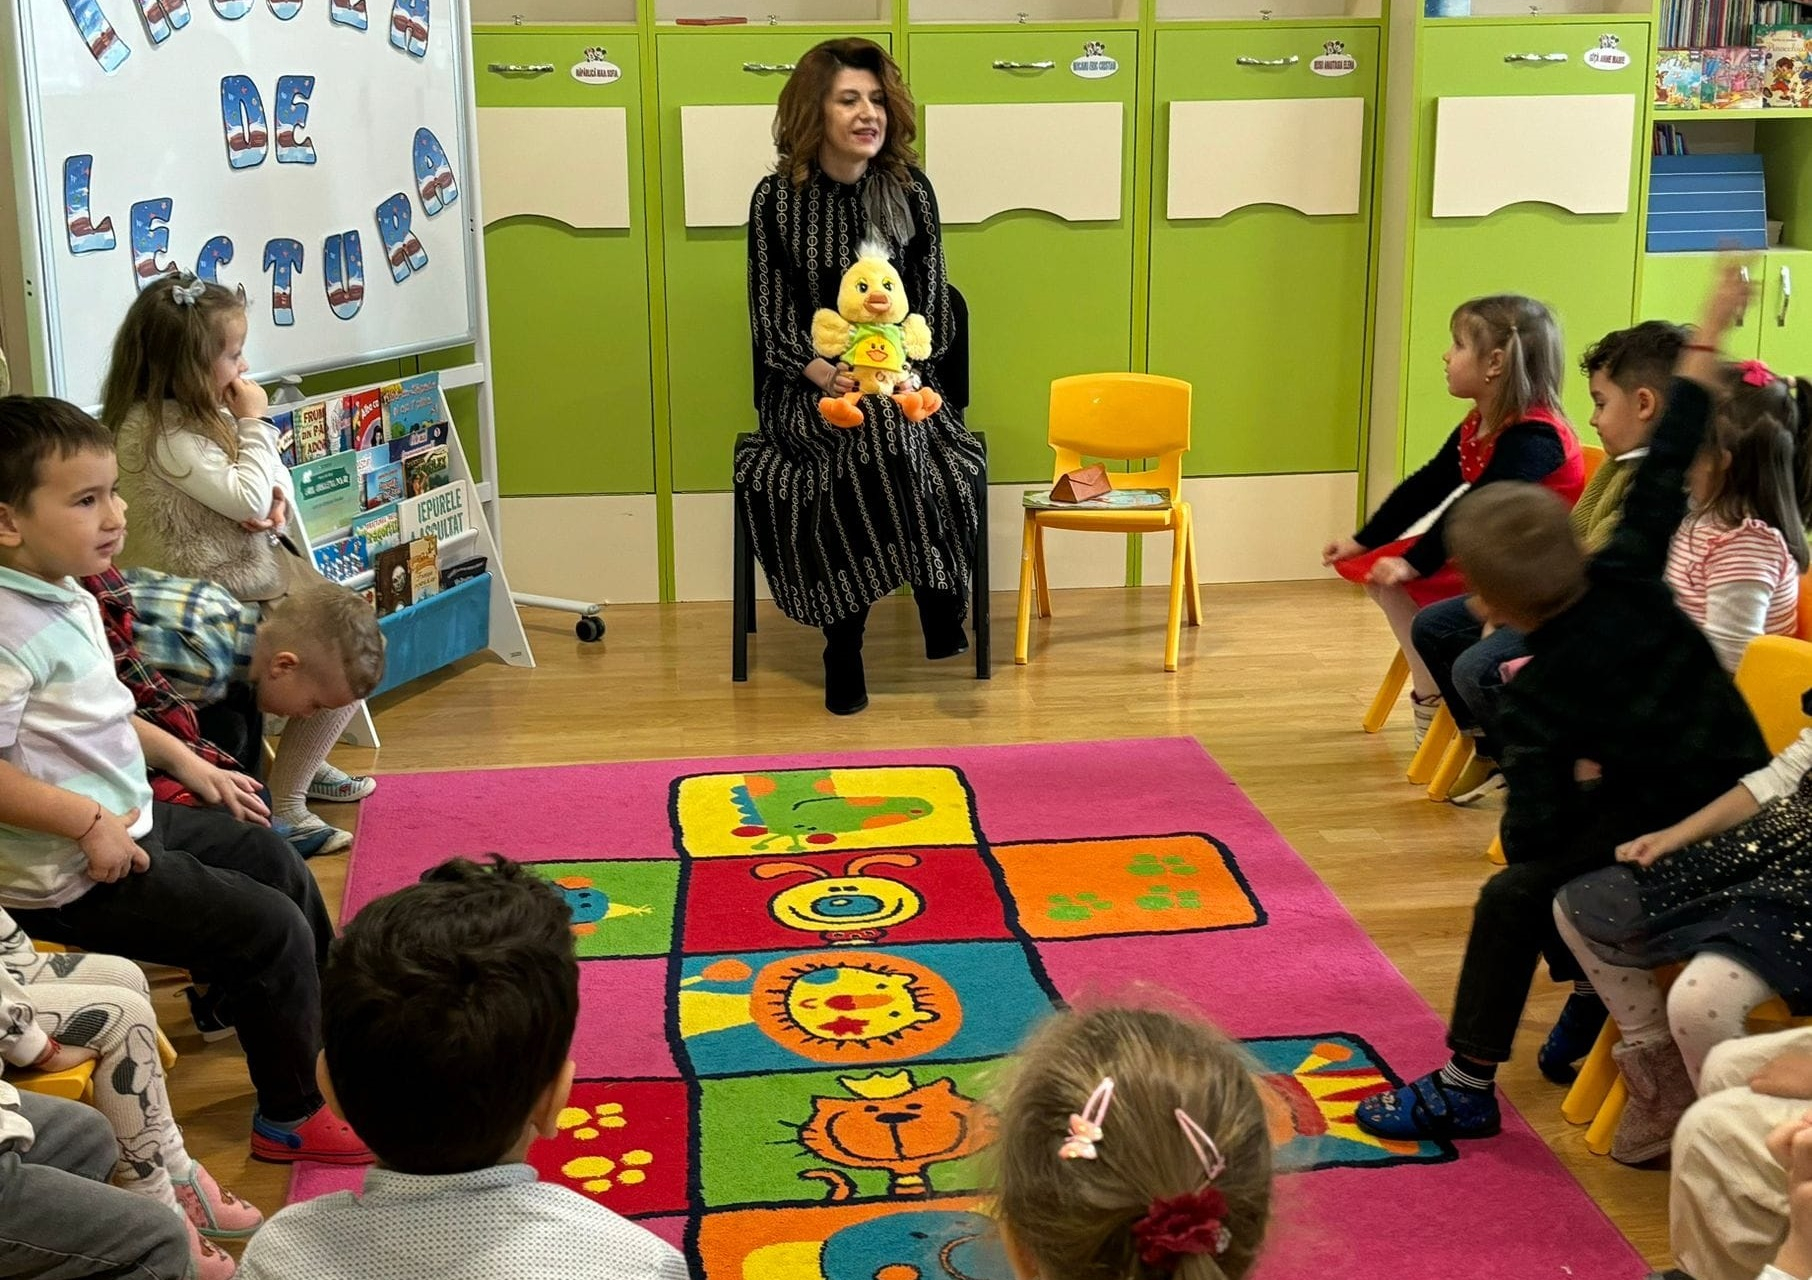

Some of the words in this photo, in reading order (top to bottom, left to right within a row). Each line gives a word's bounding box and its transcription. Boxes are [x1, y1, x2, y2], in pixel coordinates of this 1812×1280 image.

[220, 75, 317, 169] DE
[63, 127, 458, 326] LECTURA
[417, 488, 463, 524] IEPURELE
